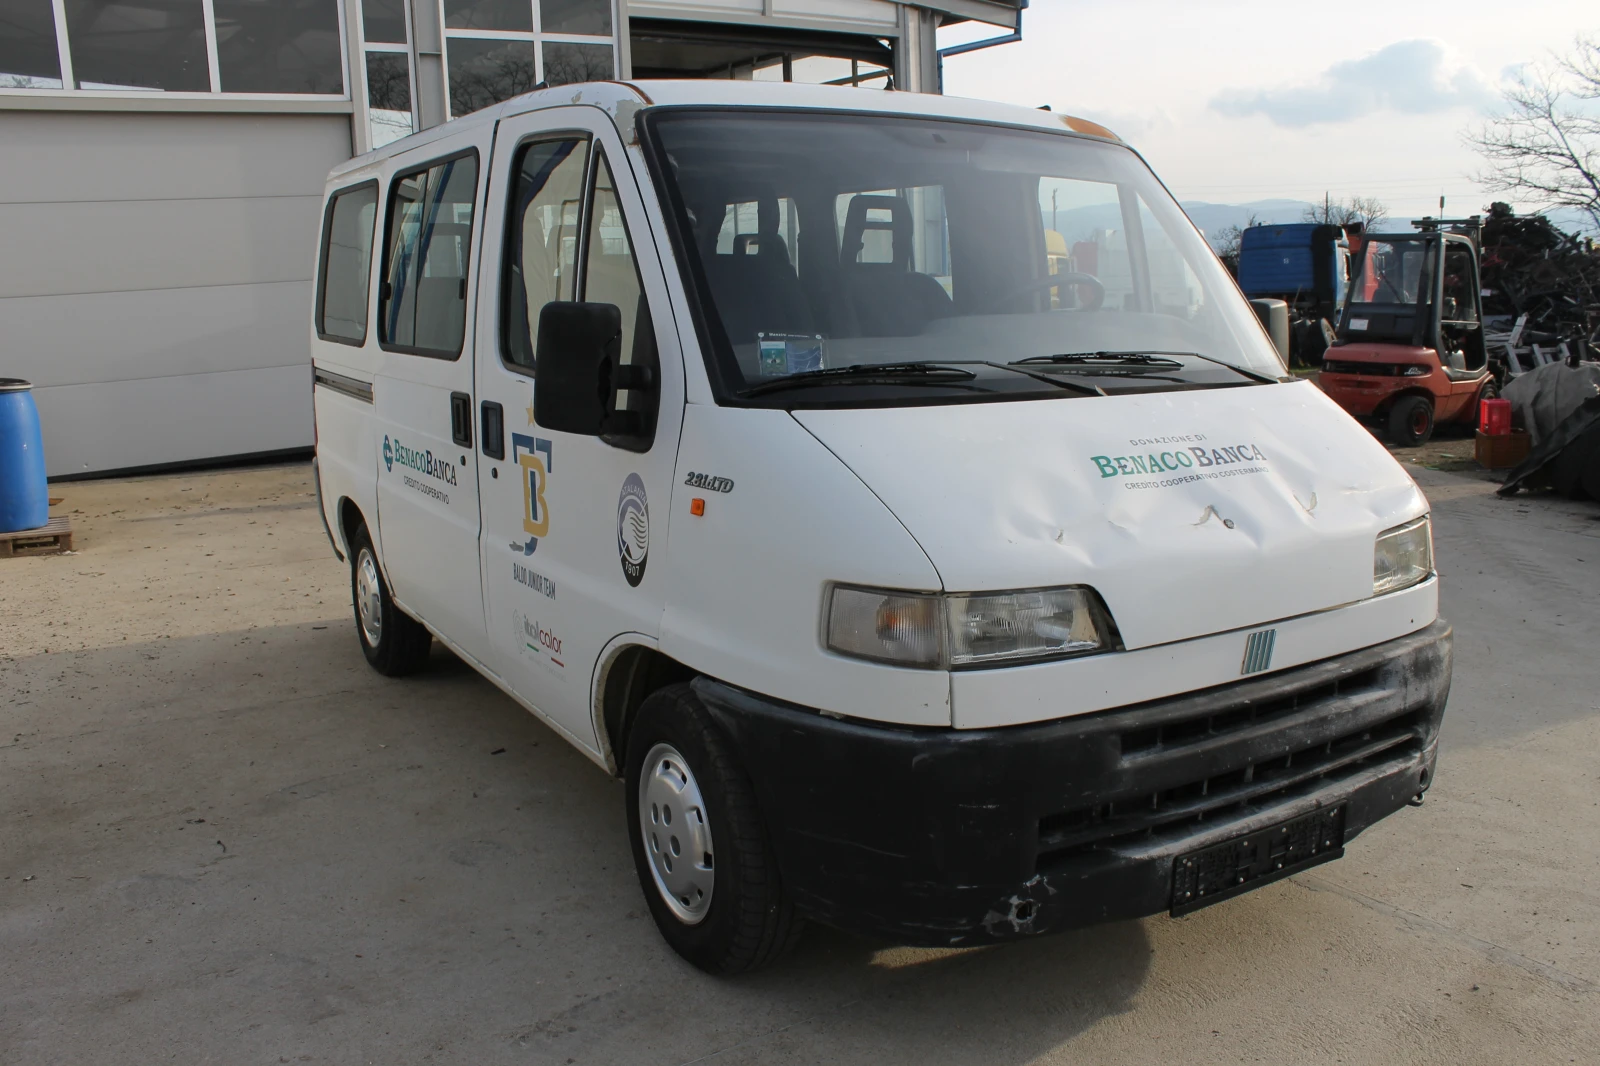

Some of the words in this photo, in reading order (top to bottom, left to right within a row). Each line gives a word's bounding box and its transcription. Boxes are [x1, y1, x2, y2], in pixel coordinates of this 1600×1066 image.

[1129, 435, 1194, 447] DONAZIONE
[1194, 433, 1208, 443] DI
[394, 438, 458, 487] BENACOBANCA
[403, 475, 421, 491] CREDITO
[420, 482, 450, 505] COOPERATIVO
[1124, 480, 1160, 490] CREDITO
[1160, 471, 1219, 488] COOPERATIVO
[1219, 466, 1270, 478] COSTERMANO
[513, 562, 528, 585] BALDO
[527, 569, 543, 594] JUNIOR
[543, 577, 556, 601] TEAM
[625, 561, 640, 577] 1907
[524, 613, 562, 656] italcolor
